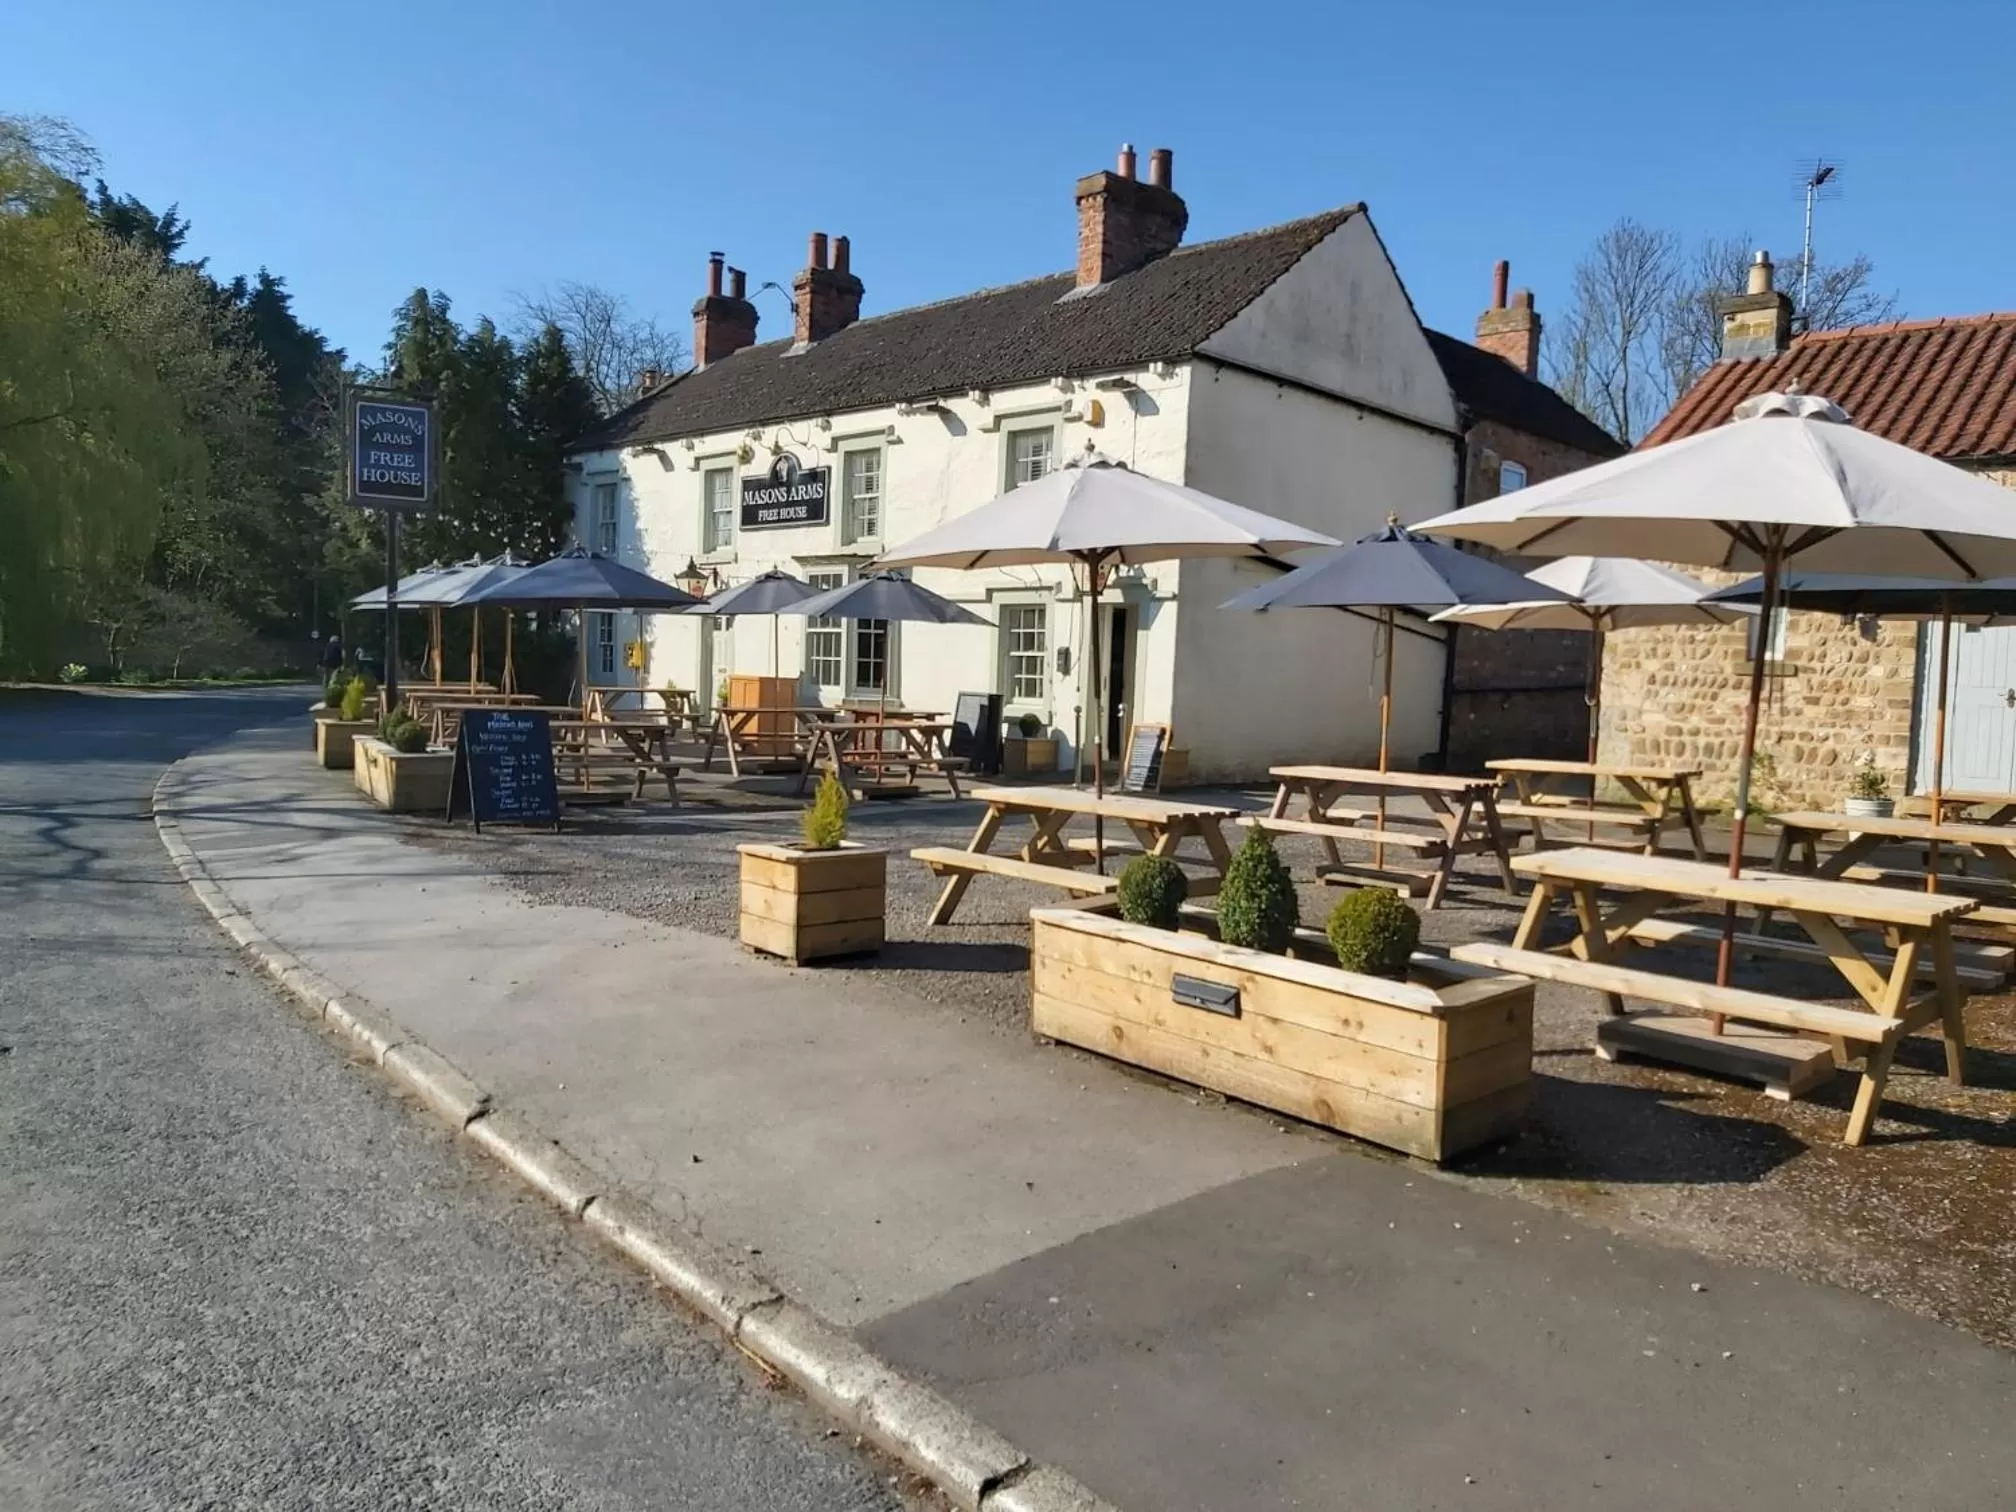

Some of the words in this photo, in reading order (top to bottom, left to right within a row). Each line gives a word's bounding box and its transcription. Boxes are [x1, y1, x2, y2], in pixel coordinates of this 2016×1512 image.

[360, 411, 423, 436] MASONS
[372, 431, 412, 445] ARMS
[369, 451, 415, 468] FREE
[362, 468, 422, 486] HOUSE
[743, 487, 787, 506] MASONS
[789, 482, 824, 501] ARMS
[758, 509, 779, 522] FREE
[780, 506, 808, 520] HOUSE
